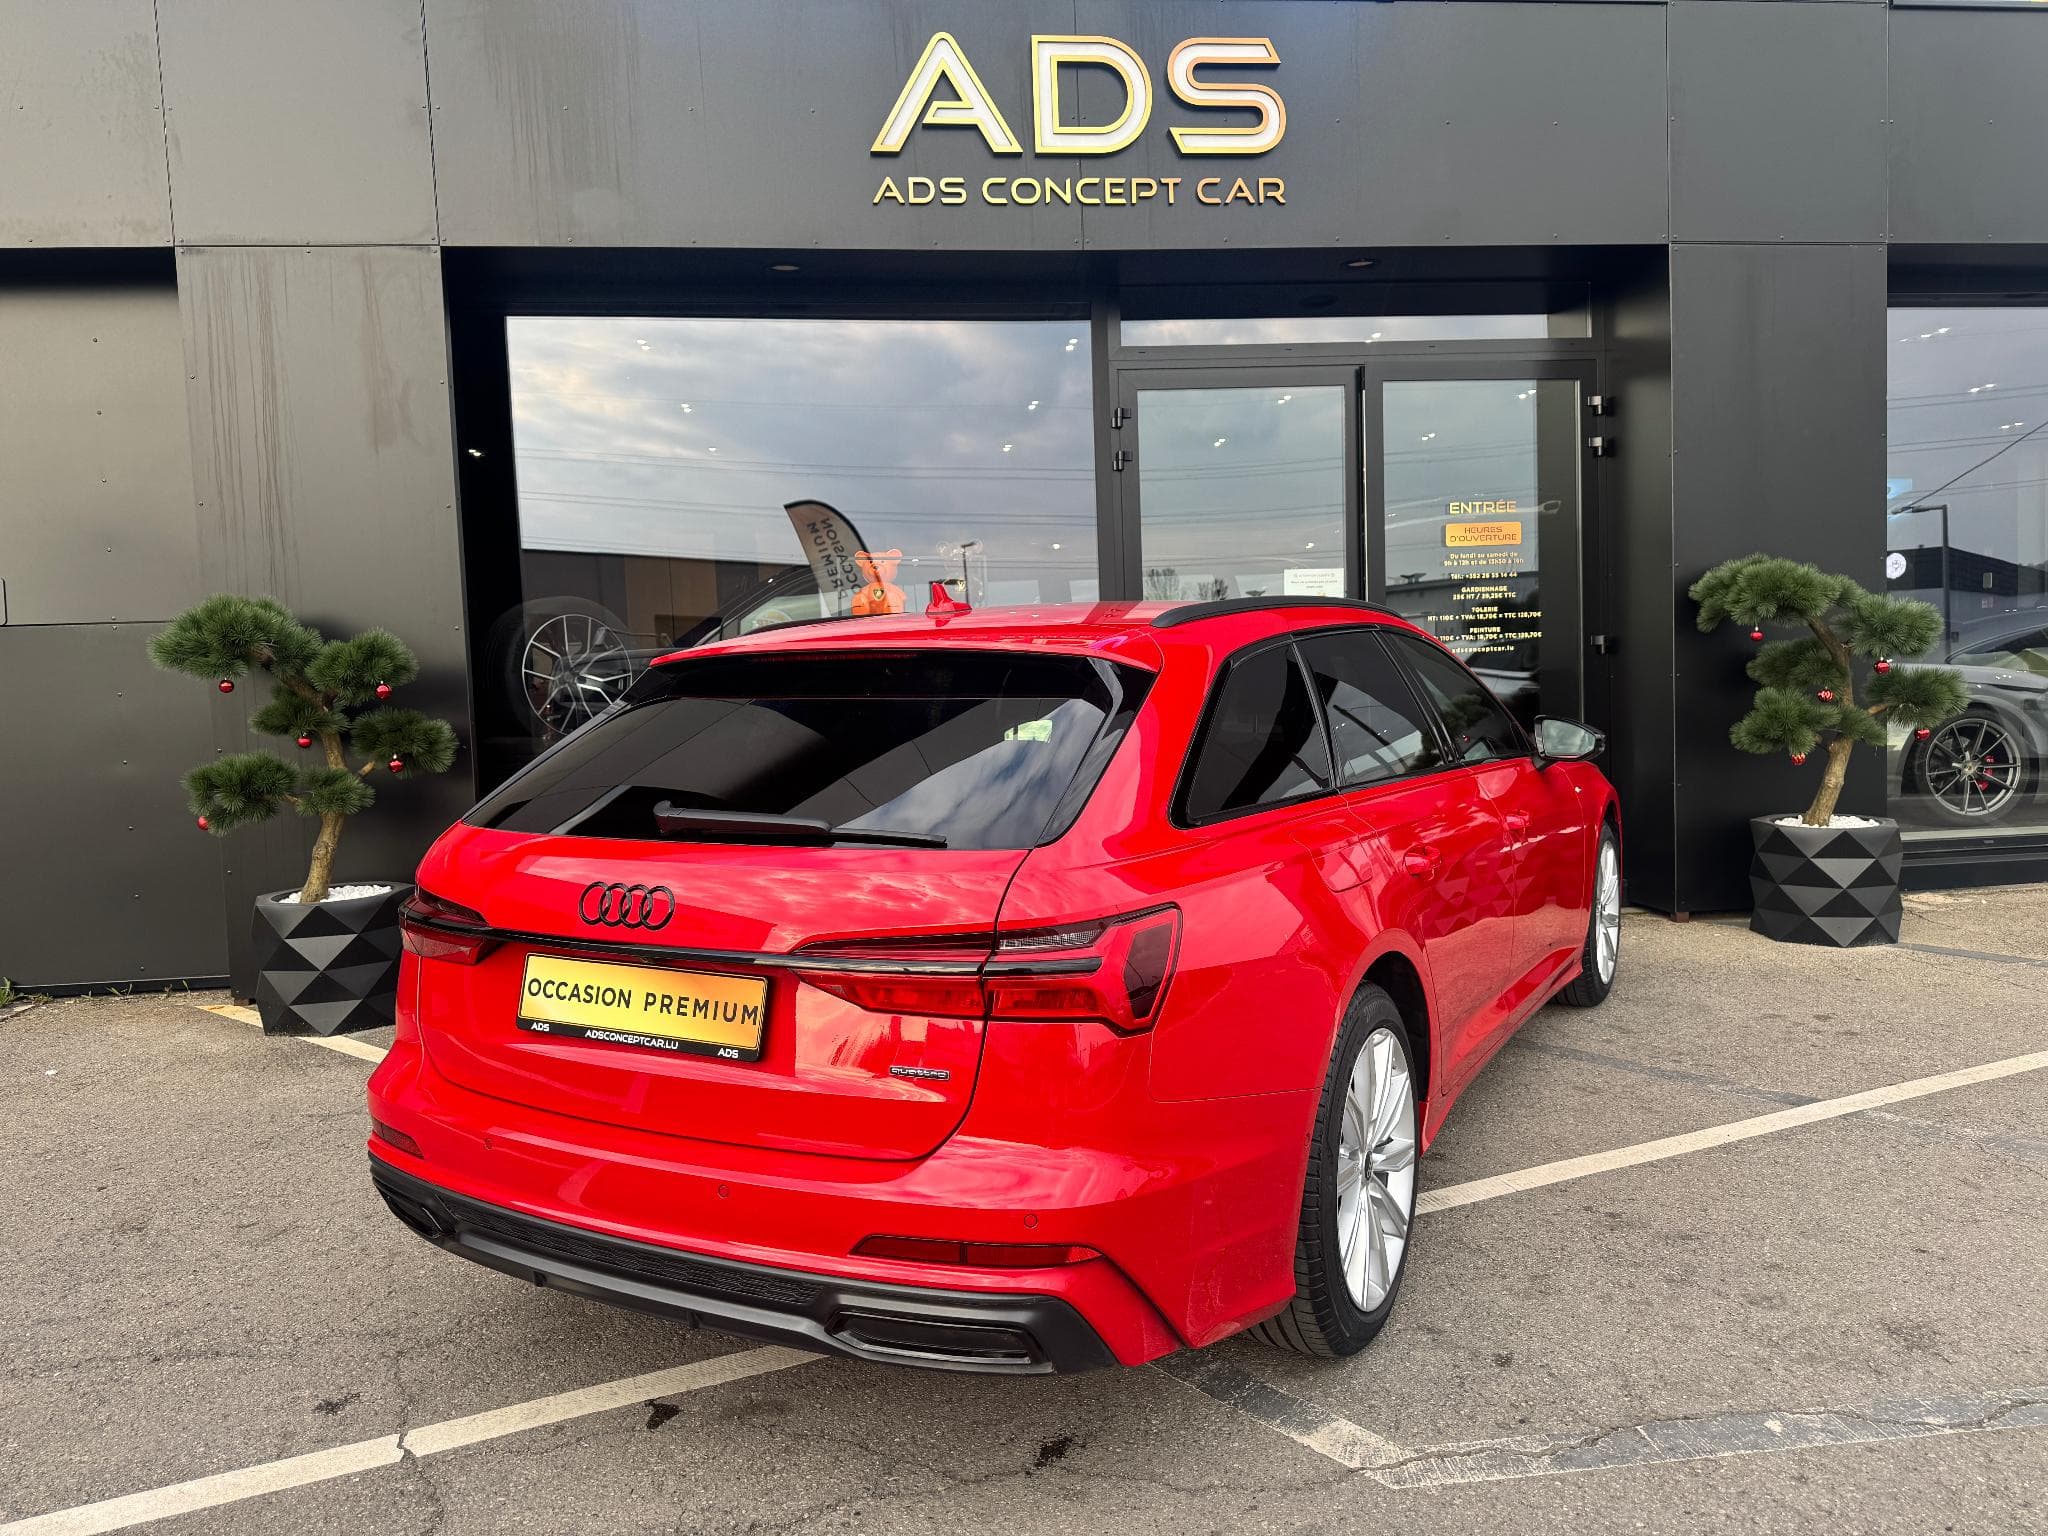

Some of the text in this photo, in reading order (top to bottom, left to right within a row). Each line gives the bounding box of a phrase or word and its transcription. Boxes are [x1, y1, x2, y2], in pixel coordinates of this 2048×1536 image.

[870, 31, 1287, 154] ADS
[872, 176, 1287, 204] ADS CONCEPT CAR
[1449, 499, 1517, 514] ENTRÉE
[1450, 533, 1517, 542] D'OUVERTURE
[1464, 526, 1503, 534] HEURES
[528, 977, 759, 1026] OCCASION PREMIUM
[530, 1022, 550, 1033] ADS
[584, 1029, 679, 1051] ADSCONCEPTCAR.LU
[717, 1047, 739, 1060] ADS
